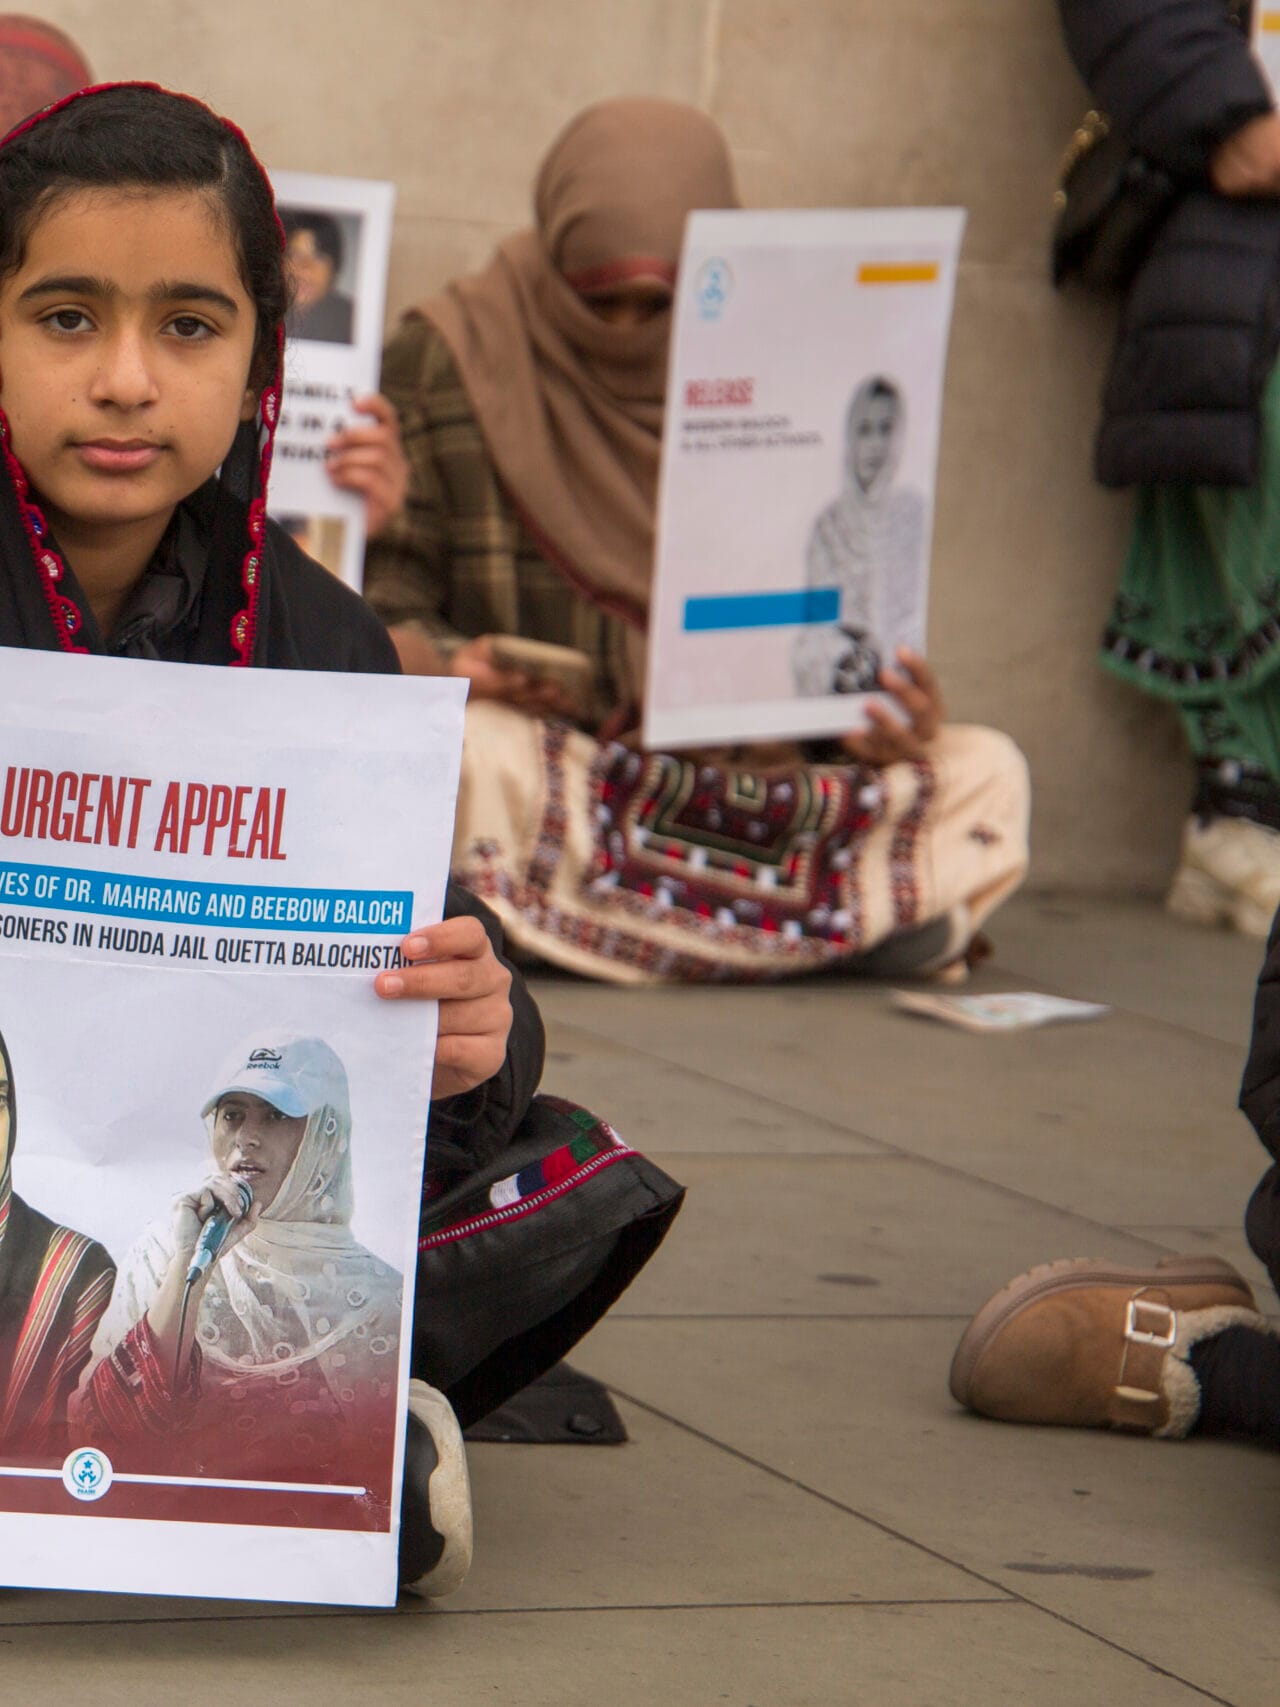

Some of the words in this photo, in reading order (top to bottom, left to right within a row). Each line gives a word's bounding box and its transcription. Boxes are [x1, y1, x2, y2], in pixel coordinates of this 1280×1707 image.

[0, 766, 152, 849] URGENT
[155, 781, 288, 861] APPEAL
[34, 875, 61, 900] OF
[64, 878, 96, 904] DR.
[102, 882, 202, 916] MAHRANG
[205, 892, 246, 919] AND
[250, 895, 330, 924] BEEBOW
[333, 900, 404, 926] BALOCH
[73, 922, 94, 948] IN
[98, 926, 165, 957] HUDDA
[169, 934, 210, 961] JAIL
[215, 937, 287, 966] QUETTA
